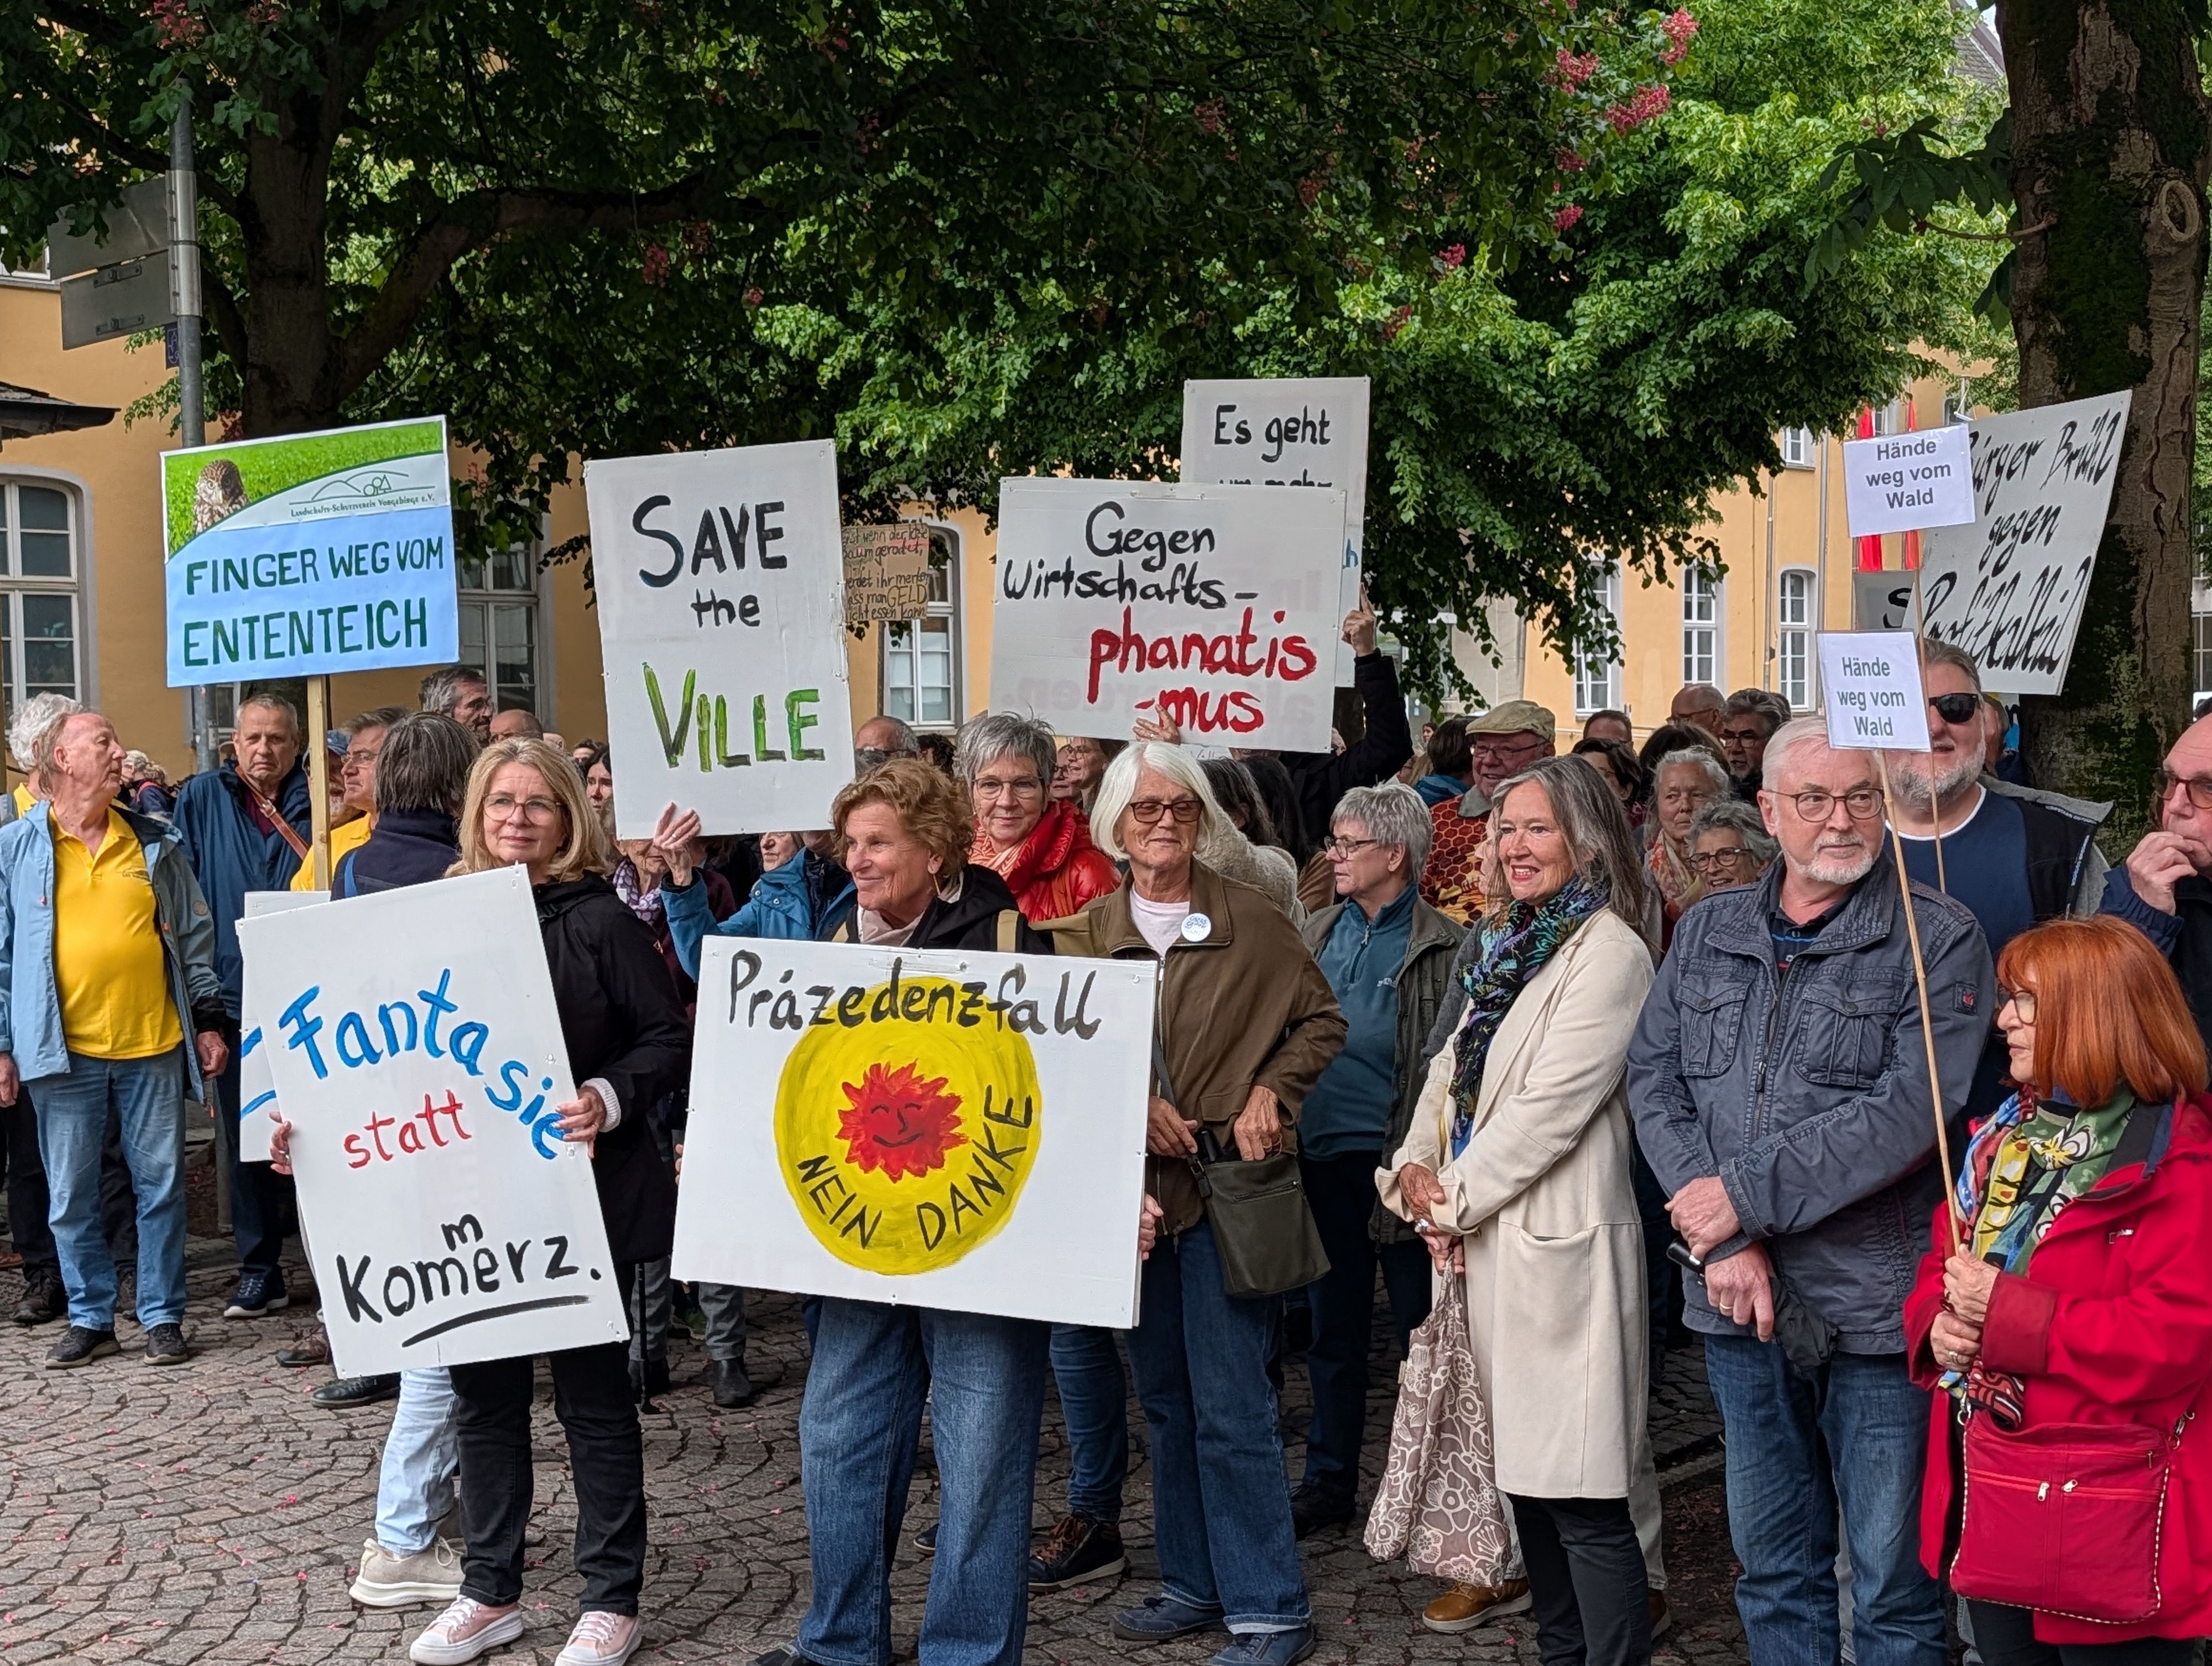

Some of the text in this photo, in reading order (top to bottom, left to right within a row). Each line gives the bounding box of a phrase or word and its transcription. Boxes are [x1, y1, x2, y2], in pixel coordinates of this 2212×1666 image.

[1214, 404, 1331, 462] Es geht
[1877, 439, 1937, 461] Hände
[1865, 464, 1951, 487] weg vom
[1886, 487, 1934, 509] Wald
[632, 495, 787, 588] SAVE
[863, 530, 885, 543] wenn
[889, 524, 908, 540] der
[1085, 501, 1215, 572] Gegen
[1979, 504, 2062, 577] gegen
[186, 535, 444, 595] FINGER WEG VOM
[877, 568, 895, 588] ihr
[690, 589, 761, 628] the
[867, 593, 887, 605] man
[887, 584, 927, 608] GELD
[872, 607, 896, 619] essen
[184, 597, 427, 667] ENTENTEICH
[1087, 605, 1317, 704] phanatis
[1841, 657, 1890, 676] Hände
[643, 662, 826, 772] VILLE
[1837, 691, 1906, 711] weg vom
[1854, 716, 1893, 736] Wald
[279, 968, 571, 1160] Fantasie
[343, 1087, 472, 1169] statt
[797, 1084, 1034, 1252] NEIN DANKE
